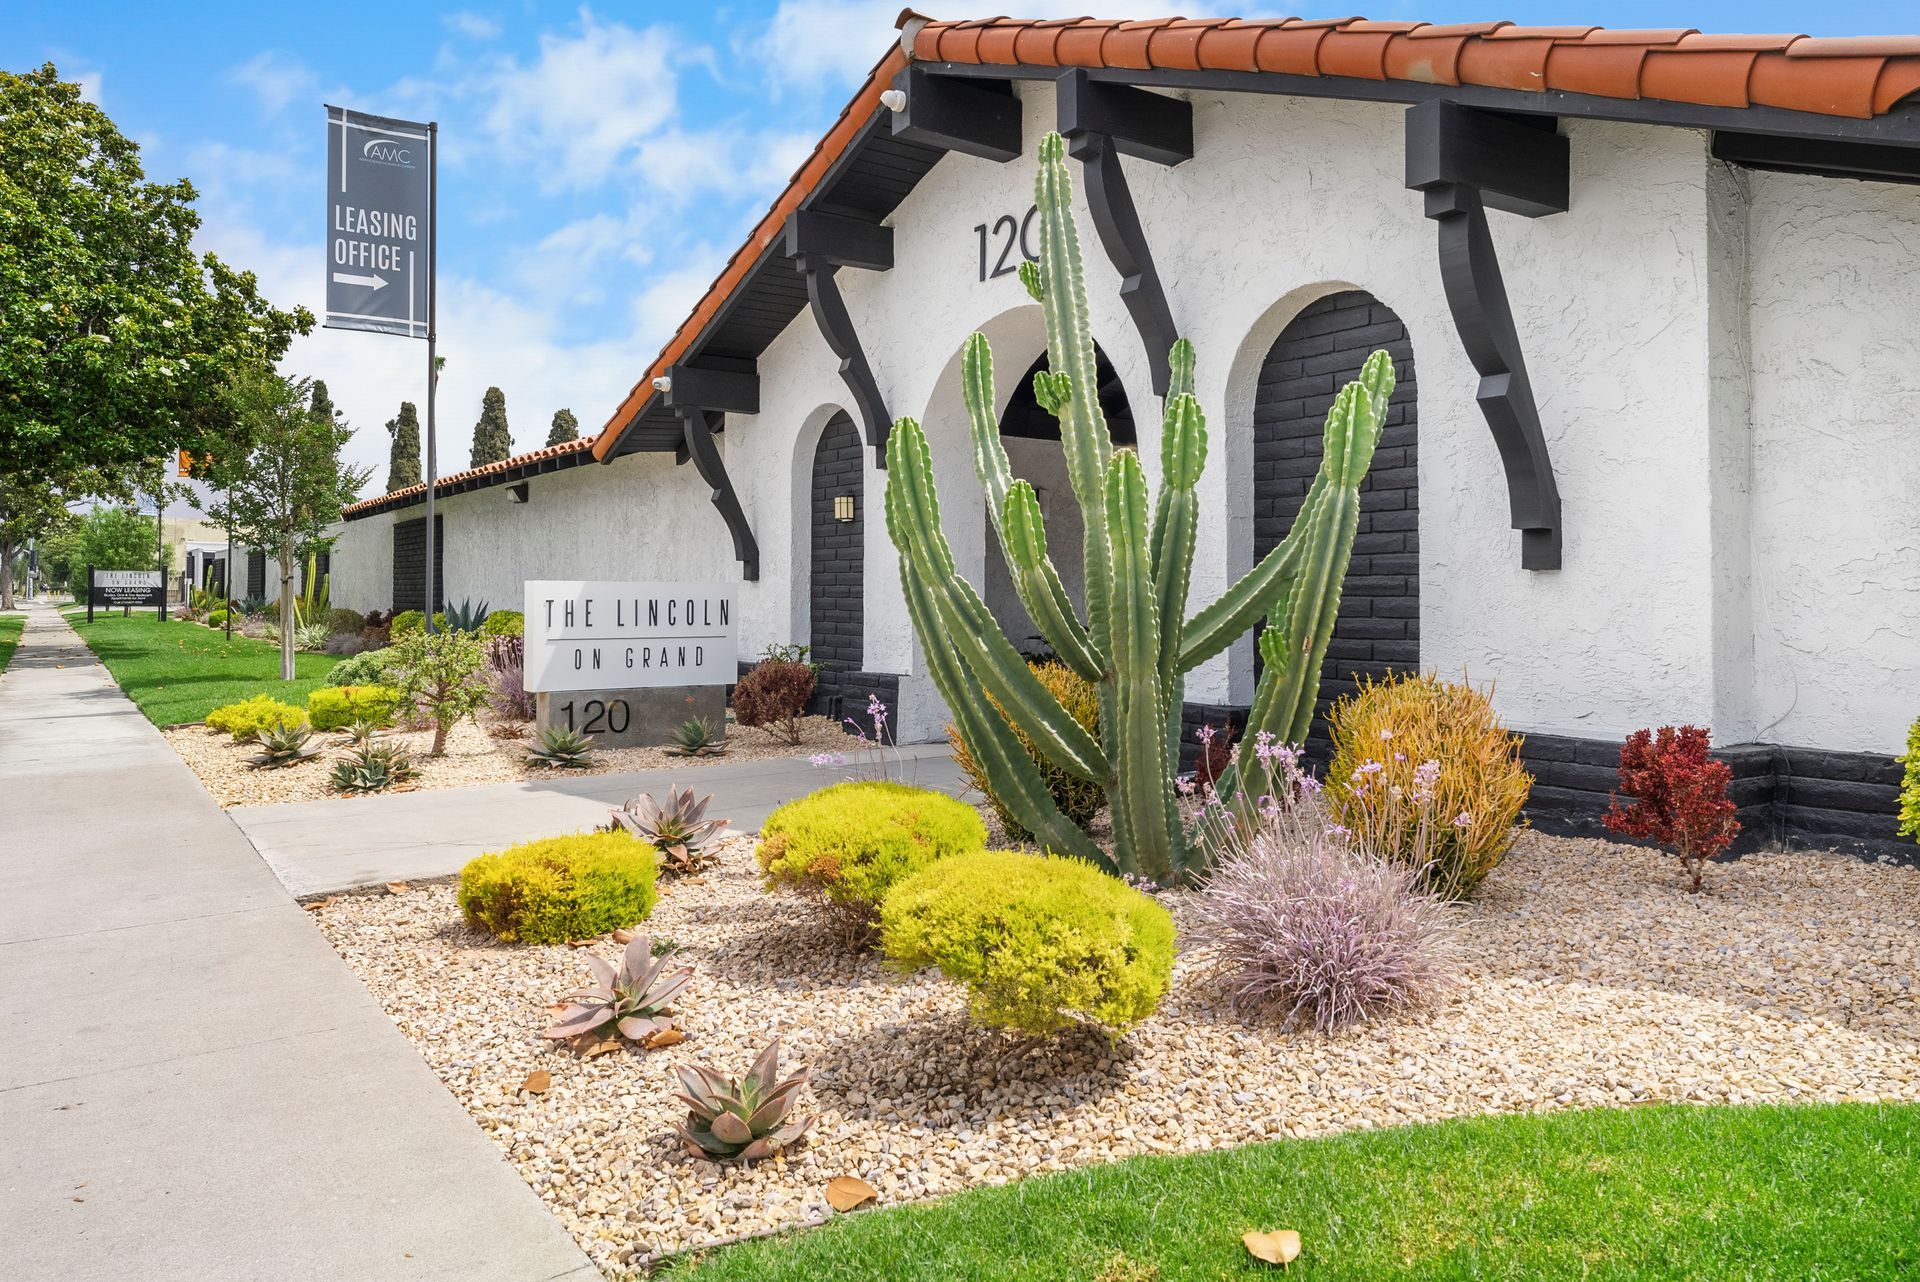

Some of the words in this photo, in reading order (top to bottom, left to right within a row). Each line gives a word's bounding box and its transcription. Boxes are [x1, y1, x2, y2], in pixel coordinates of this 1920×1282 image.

[370, 145, 411, 165] AMC
[335, 204, 417, 241] LEASING
[334, 237, 401, 272] OFFICE
[545, 599, 593, 628] THE
[617, 599, 730, 627] LINCOLN
[574, 648, 601, 670] ON
[625, 646, 703, 669] GRAND
[560, 699, 631, 735] 120
